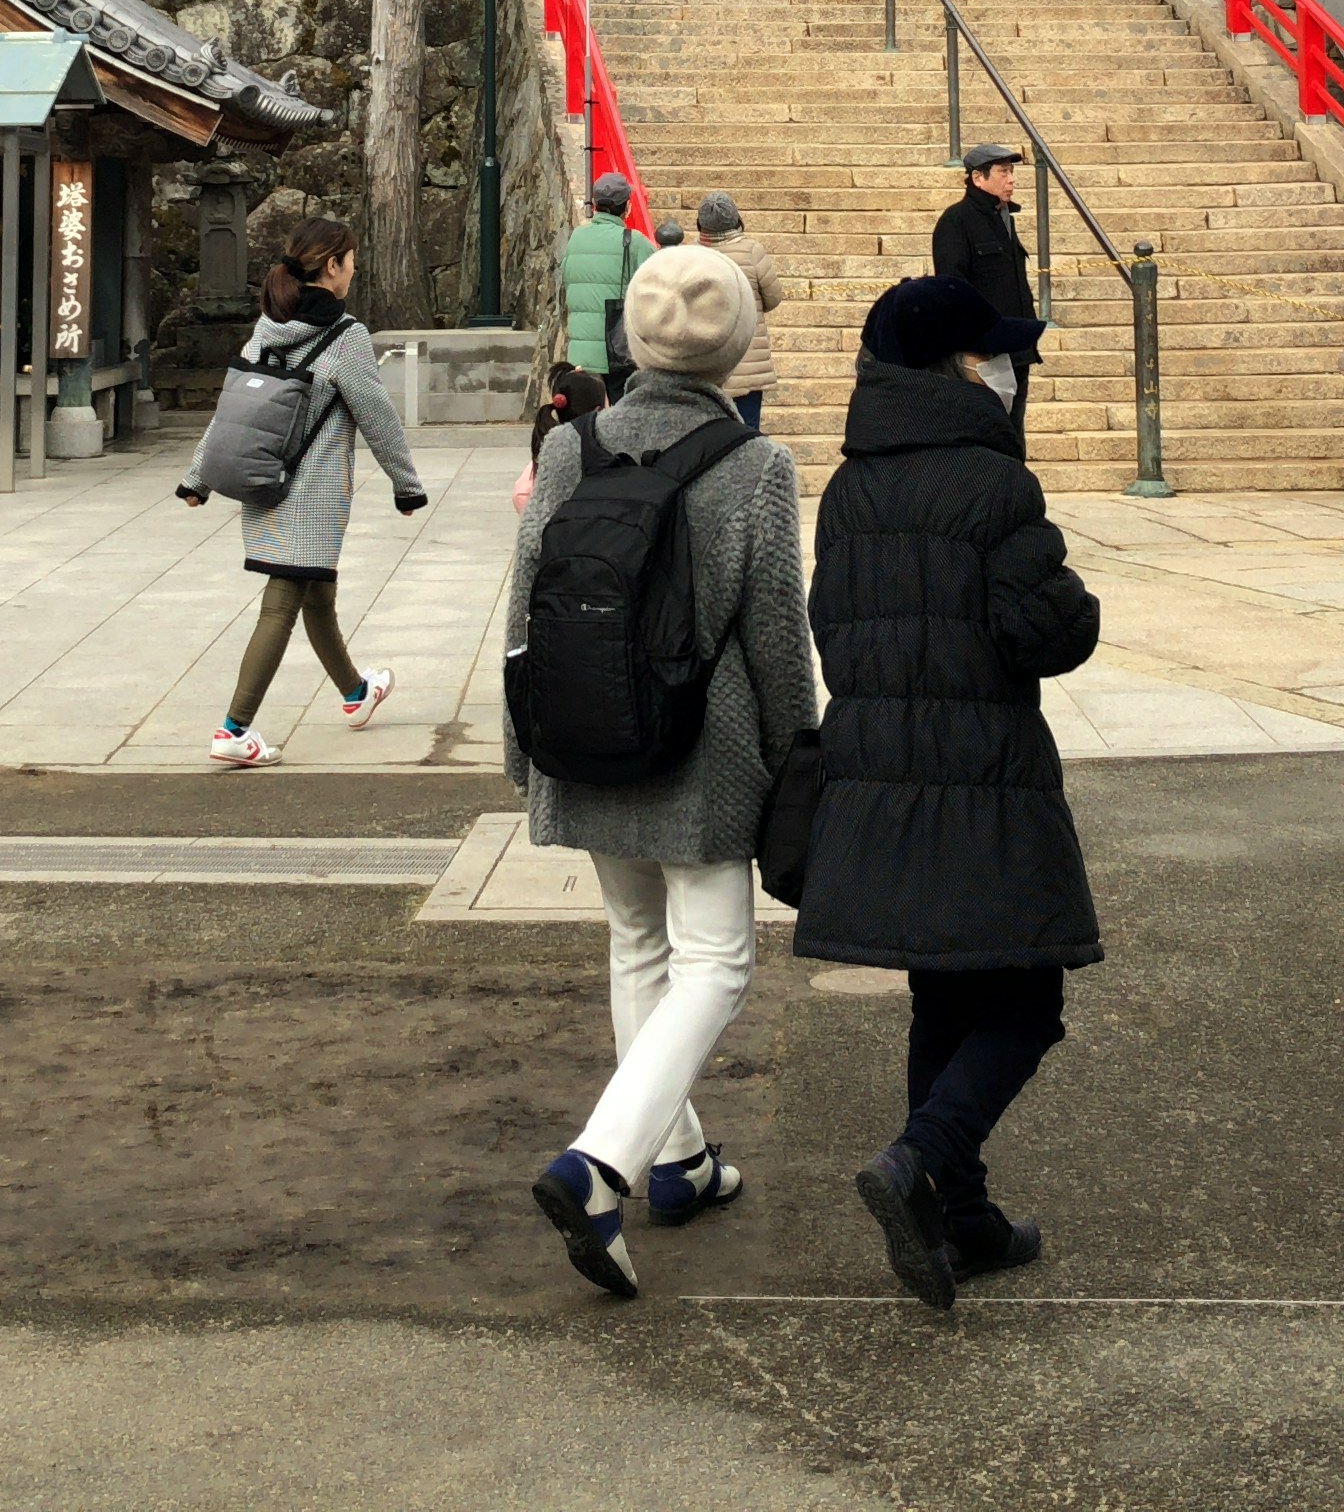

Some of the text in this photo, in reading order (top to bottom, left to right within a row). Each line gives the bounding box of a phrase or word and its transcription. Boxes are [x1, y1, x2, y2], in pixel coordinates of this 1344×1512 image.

[55, 181, 89, 354] 塔婆おさめ所
